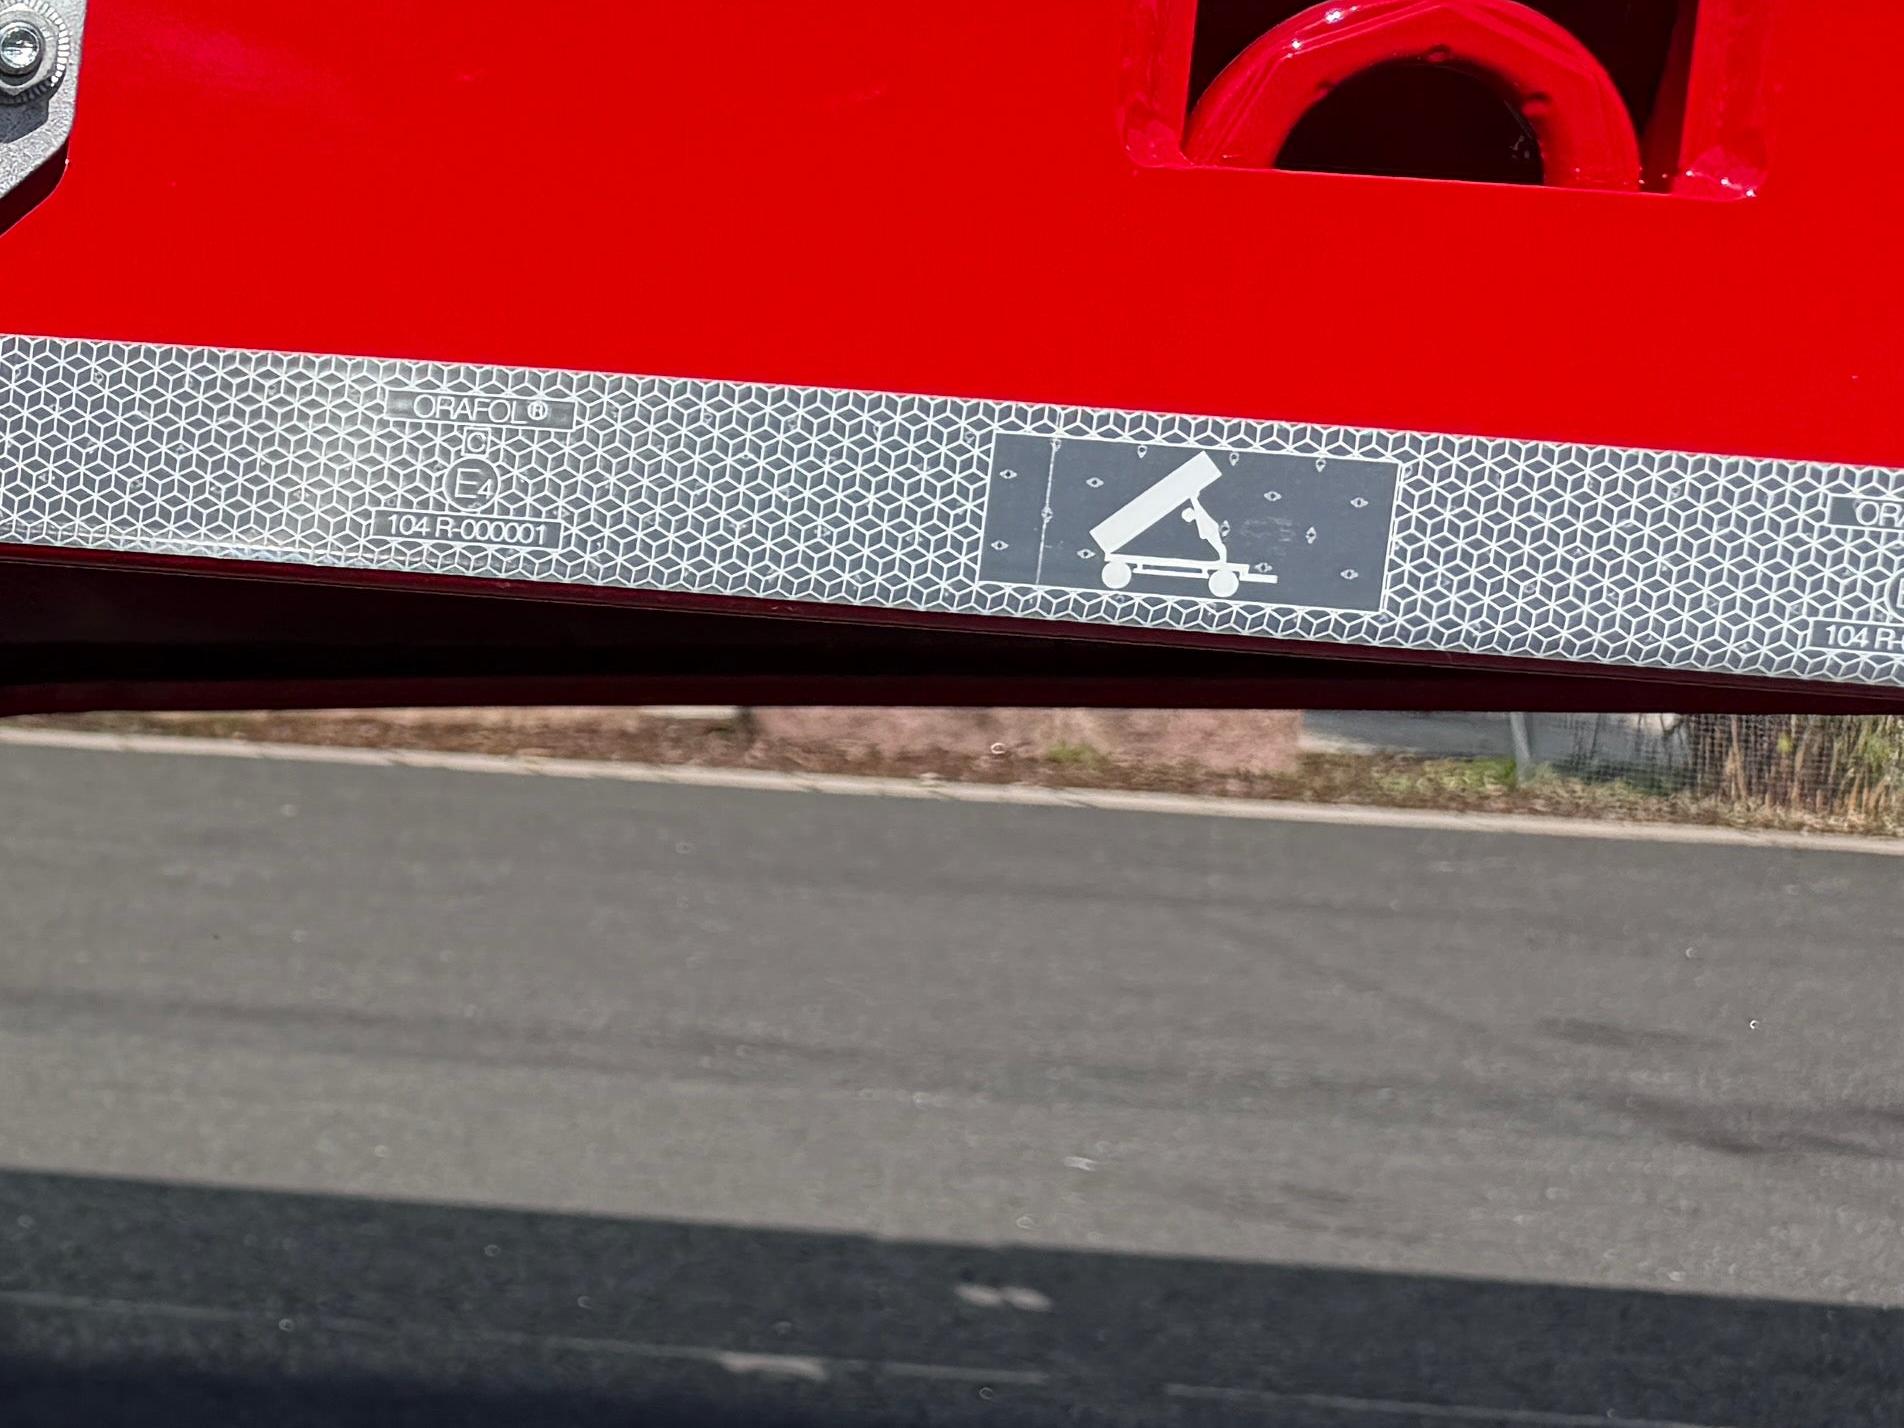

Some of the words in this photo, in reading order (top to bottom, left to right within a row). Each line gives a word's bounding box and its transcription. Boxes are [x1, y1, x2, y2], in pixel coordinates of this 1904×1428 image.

[388, 514, 430, 536] 104
[435, 517, 546, 545] R-000001
[1825, 624, 1869, 647] 104
[1875, 627, 1904, 650] R-
